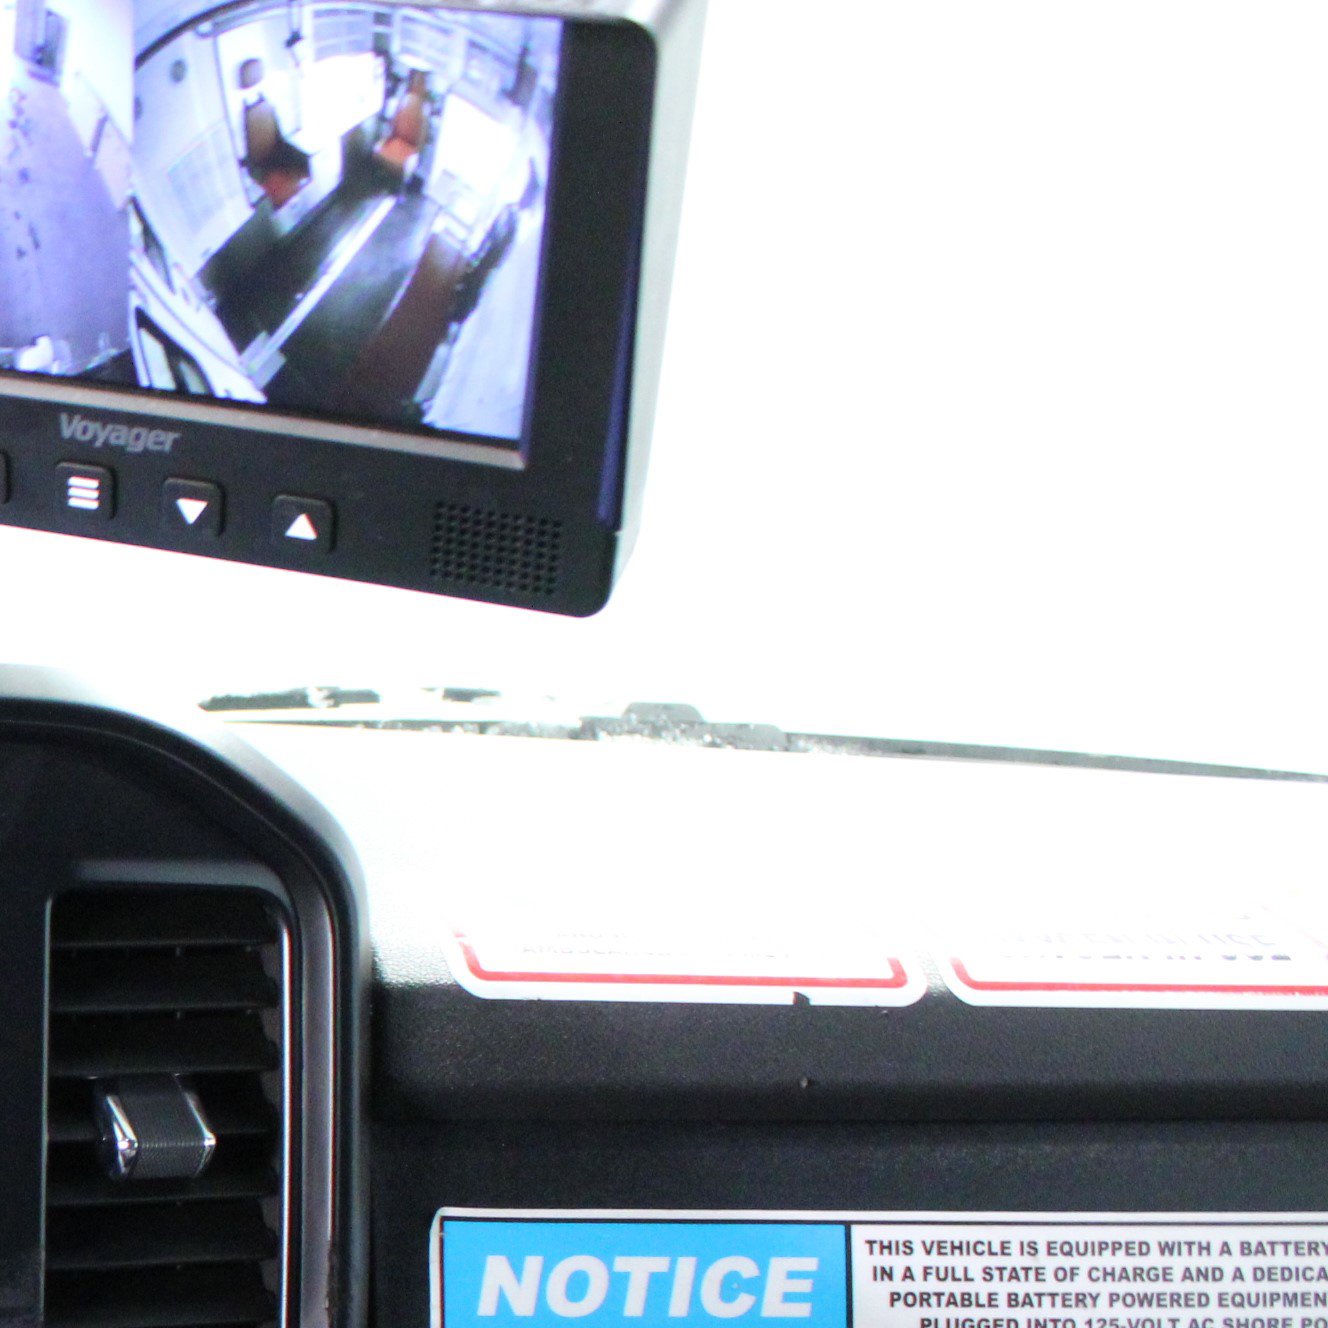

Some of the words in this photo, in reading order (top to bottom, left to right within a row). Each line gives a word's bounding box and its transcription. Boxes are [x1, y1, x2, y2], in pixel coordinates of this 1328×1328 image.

[59, 411, 181, 453] Voyager
[864, 1239, 914, 1257] THIS
[921, 1240, 1012, 1258] VEHICLE
[1020, 1240, 1039, 1258] IS
[1046, 1240, 1151, 1258] EQUIPPED
[1158, 1241, 1211, 1257] WITH
[1219, 1241, 1232, 1257] A
[873, 1265, 894, 1283] IN
[901, 1266, 916, 1283] A
[923, 1266, 975, 1283] FULL
[982, 1266, 1046, 1283] STATE
[1053, 1266, 1080, 1283] OF
[1088, 1266, 1173, 1283] CHARGE
[1181, 1267, 1224, 1283] AND
[1232, 1267, 1245, 1283] A
[1252, 1266, 1328, 1283] DEDICA
[477, 1254, 820, 1319] NOTICE
[889, 1291, 999, 1309] PORTABLE
[1007, 1292, 1100, 1309] BATTERY
[1109, 1292, 1210, 1309] POWERED
[1218, 1292, 1327, 1309] EQUIPMEN
